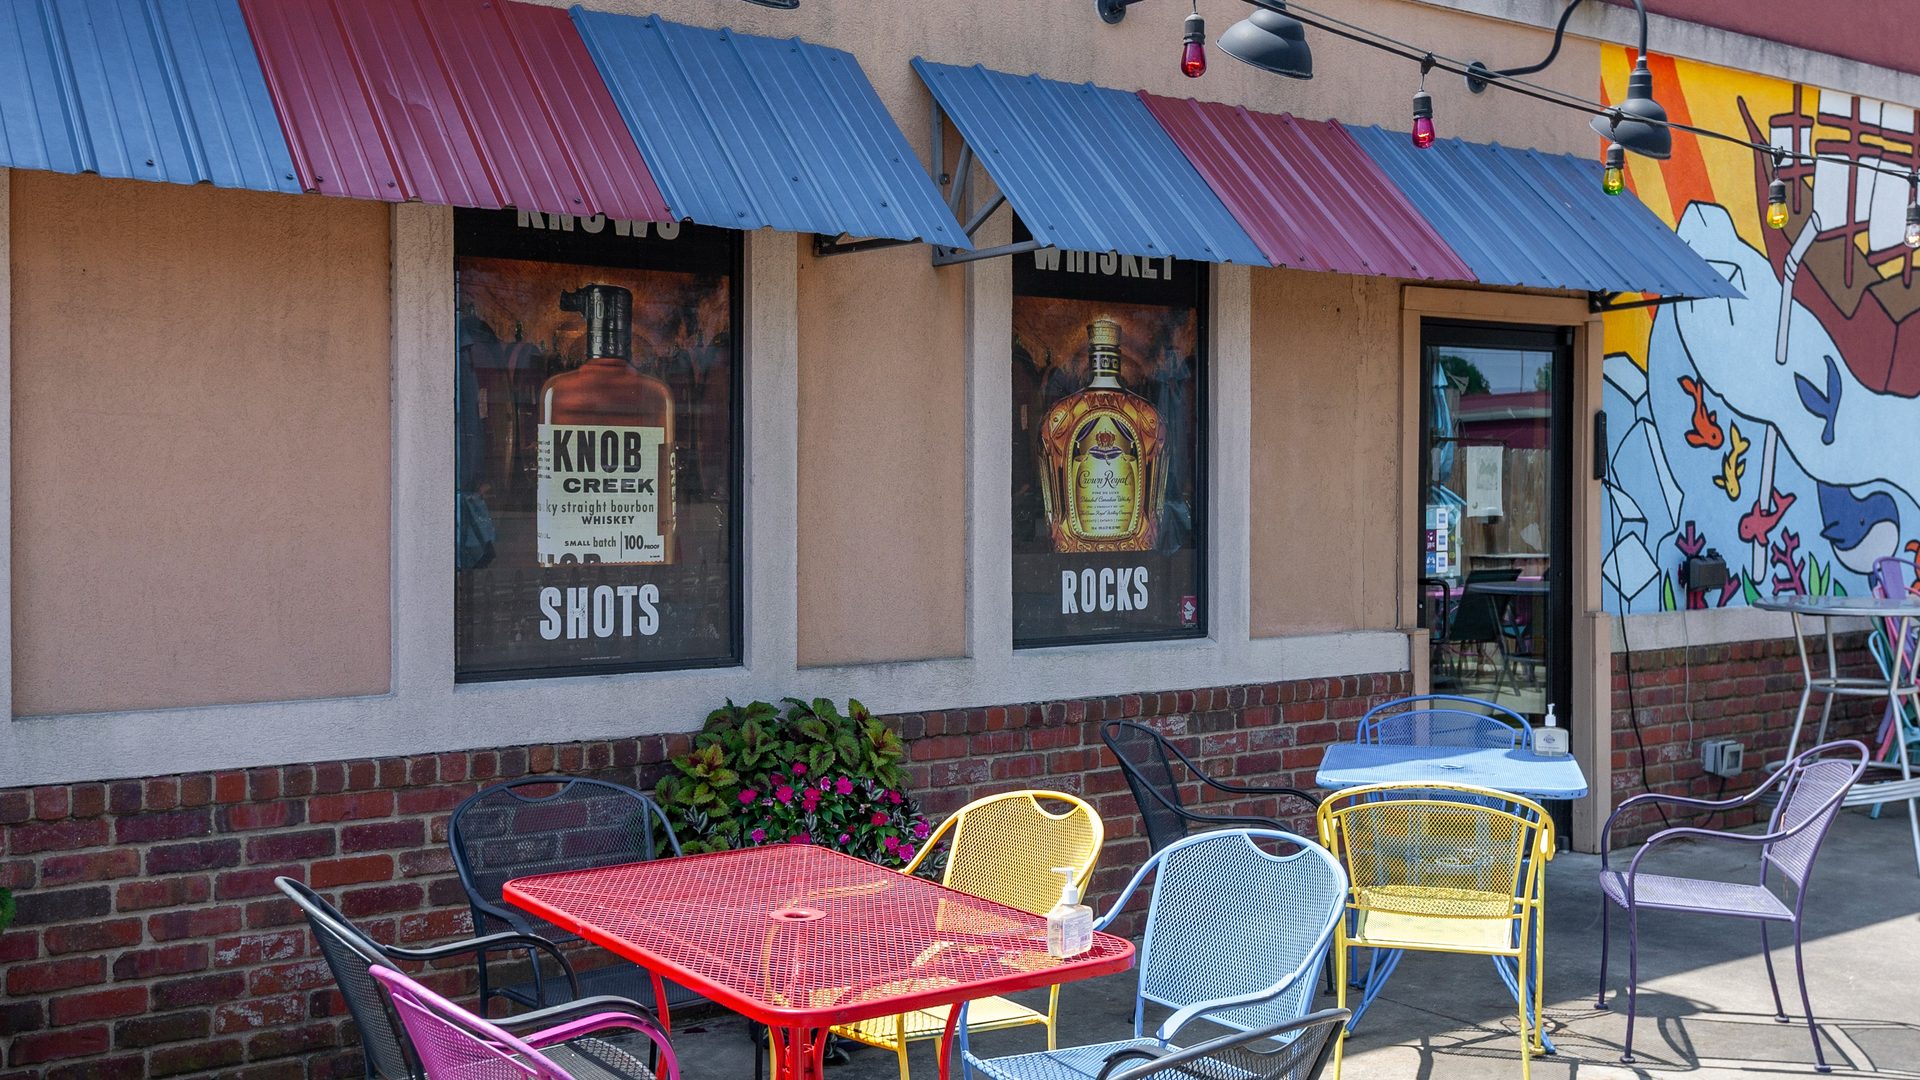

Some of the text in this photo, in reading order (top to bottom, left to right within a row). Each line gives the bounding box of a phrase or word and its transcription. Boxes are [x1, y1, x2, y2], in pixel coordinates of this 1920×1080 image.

[553, 430, 641, 473] KNOB
[563, 478, 655, 494] CREEK
[1078, 469, 1131, 488] Crown Royal
[561, 499, 606, 516] straight
[611, 499, 654, 513] bourbon
[581, 515, 635, 525] WHISKEY
[593, 536, 617, 548] batch
[624, 535, 644, 550] 100
[1062, 566, 1149, 614] ROCKS
[539, 583, 660, 640] SHOTS
